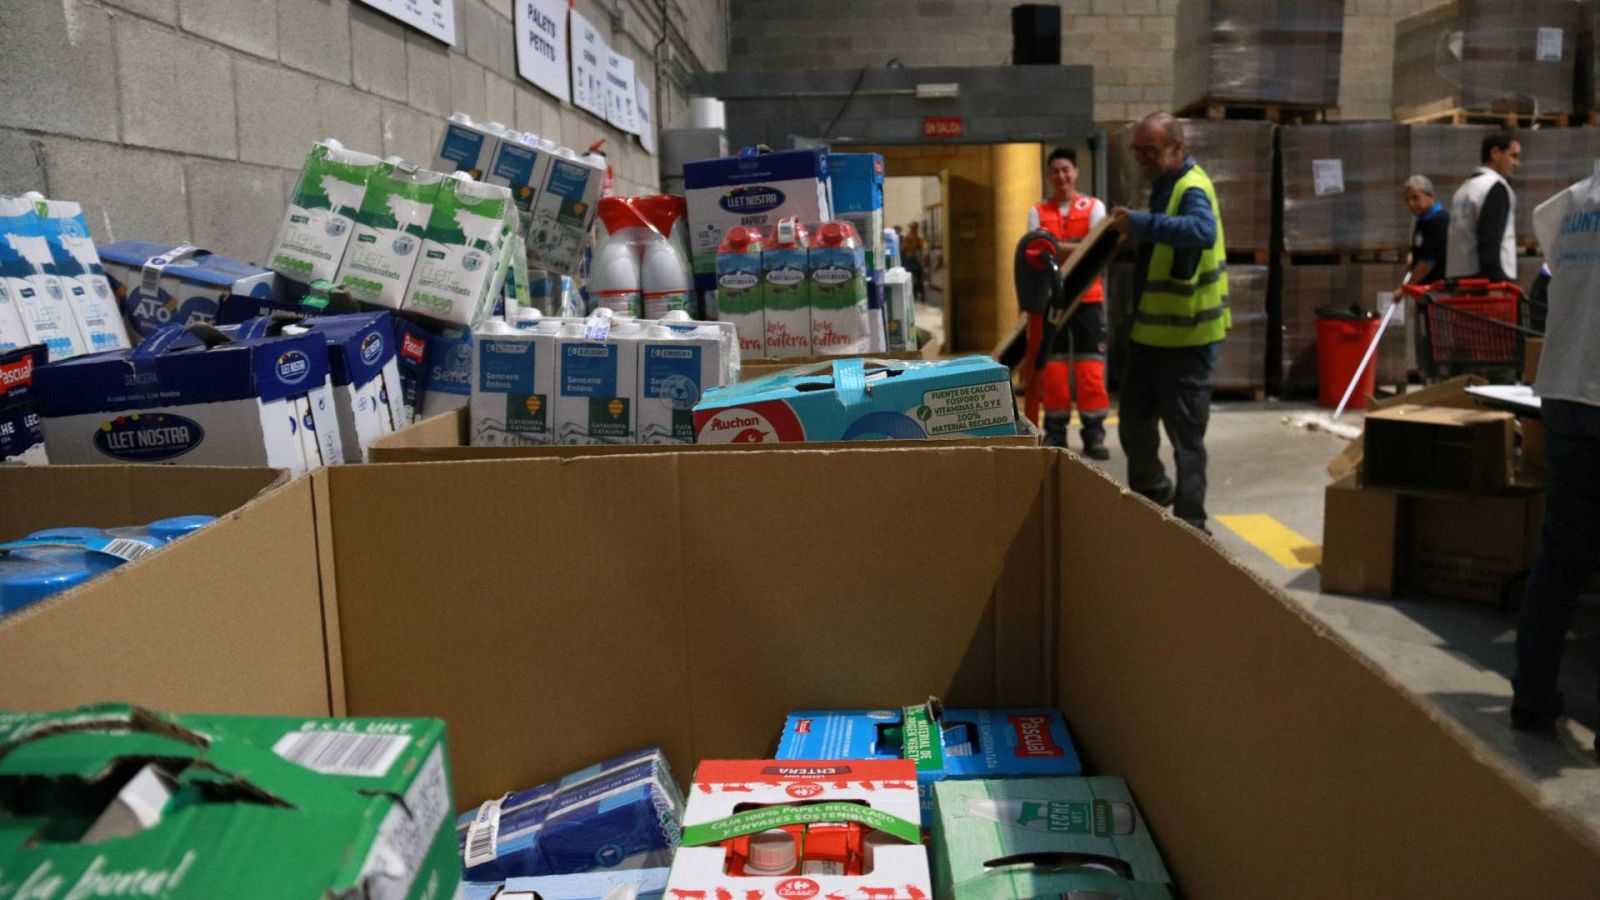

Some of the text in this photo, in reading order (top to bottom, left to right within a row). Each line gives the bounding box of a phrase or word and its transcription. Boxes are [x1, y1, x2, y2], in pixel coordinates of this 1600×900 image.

[527, 3, 556, 39] PALETS
[529, 30, 556, 62] PETITS
[727, 193, 777, 208] LLET NOSTRA
[133, 298, 171, 323] ATO
[767, 330, 809, 349] entera
[813, 330, 852, 348] entera
[0, 359, 33, 385] ascual
[931, 384, 999, 400] FUENTE DE CALCIO,
[934, 402, 975, 414] VITAMINAS
[958, 412, 982, 421] 100%
[711, 416, 760, 432] Auchan
[931, 416, 1008, 433] MATERIAL RECICLADO
[106, 425, 190, 449] LLET NOSTRA
[366, 721, 413, 734] UHT
[1019, 716, 1055, 757] Pascual
[918, 719, 932, 760] MATERIAL DE
[778, 766, 837, 775] ENTERA
[710, 804, 896, 831] CAJA 100% PAPEL RECICLADO
[734, 816, 792, 833] ENVASES
[794, 812, 884, 827] SOSTENIBLES
[1051, 802, 1070, 831] LECHE
